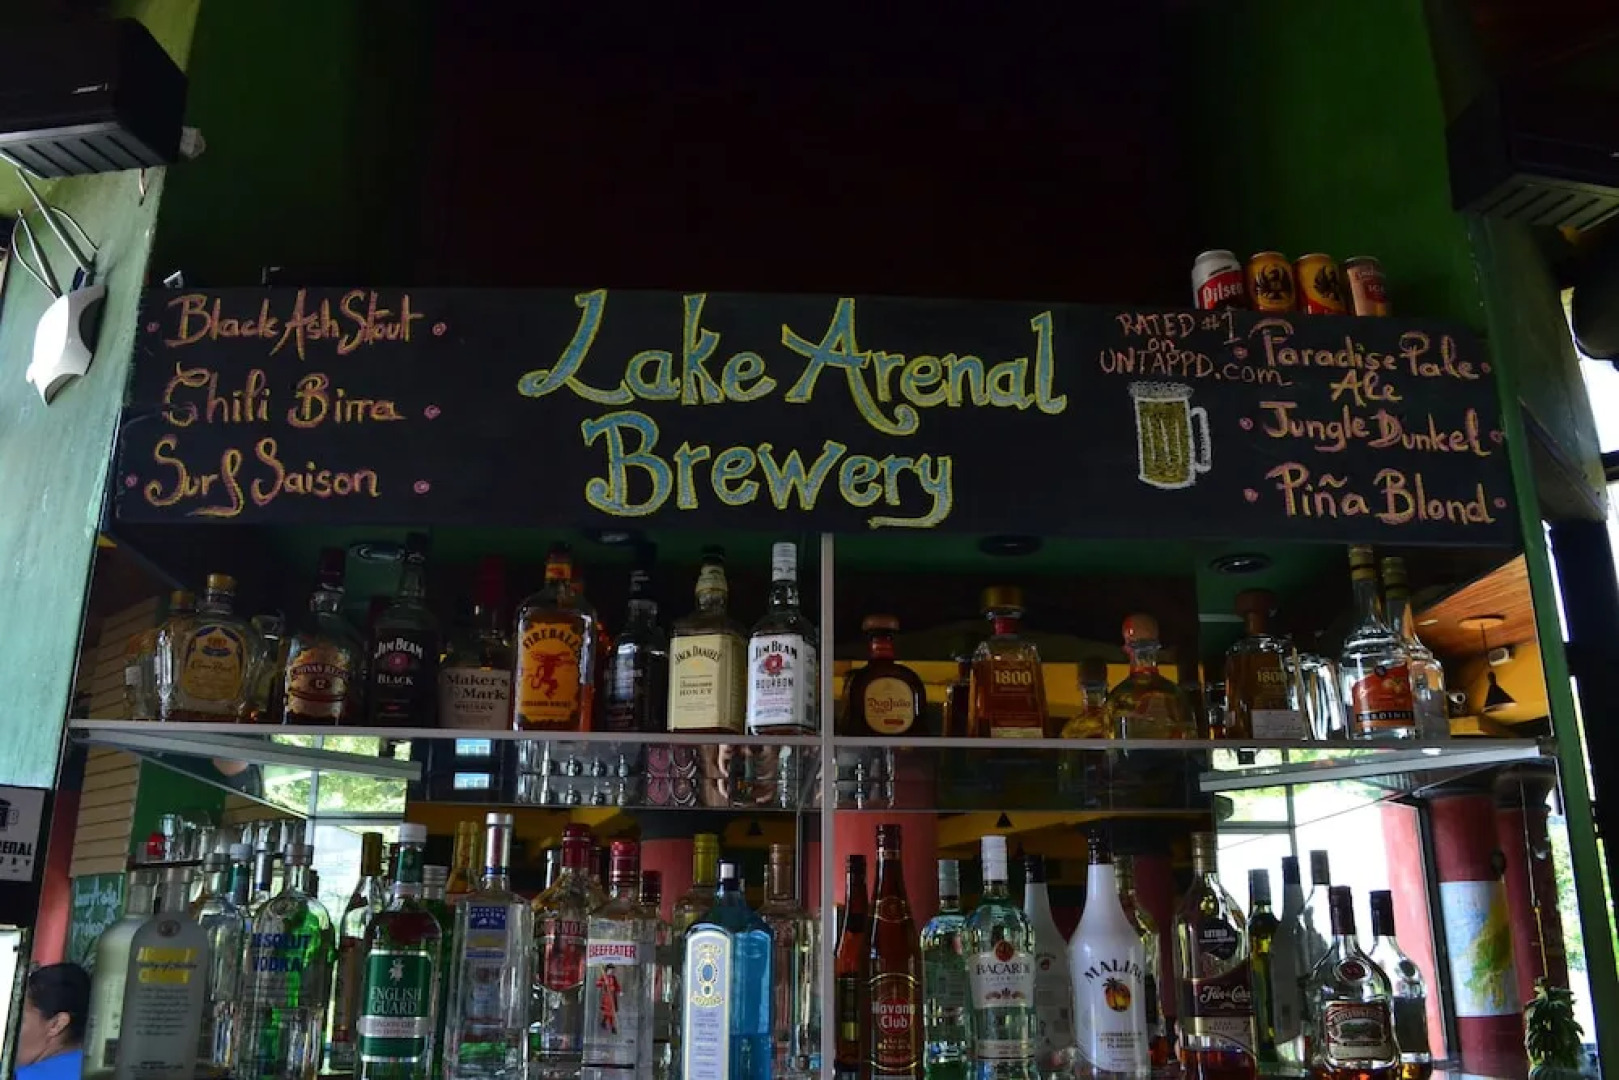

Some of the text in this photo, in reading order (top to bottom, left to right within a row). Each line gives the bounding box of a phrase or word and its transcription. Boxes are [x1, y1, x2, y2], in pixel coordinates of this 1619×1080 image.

[1202, 280, 1245, 309] Pilsen
[165, 288, 425, 360] Black Ash Stout
[1116, 305, 1241, 346] RATED #1
[1147, 338, 1177, 355] on
[1248, 318, 1481, 380] Paradise Pale
[517, 287, 1068, 436] Lake Arenal
[162, 362, 271, 427] Chili
[1330, 369, 1404, 407] Ale
[1259, 400, 1492, 457] Jungle Dunkel
[144, 436, 382, 518] Surf Saison
[580, 409, 956, 529] Brewery
[1265, 460, 1496, 526] Piña Blond
[373, 637, 424, 660] JIM BEAM
[675, 650, 692, 663] JACK
[755, 641, 798, 661] JIM BEAM
[376, 674, 414, 686] BLACK
[447, 674, 508, 687] Maker's
[756, 677, 794, 689] BOURBON
[993, 669, 1032, 686] 1800
[462, 688, 508, 700] Mark
[589, 943, 637, 959] BEEFEATER
[370, 986, 422, 1000] ENGLISH
[372, 1000, 417, 1015] GUARD
[880, 1015, 908, 1029] Club
